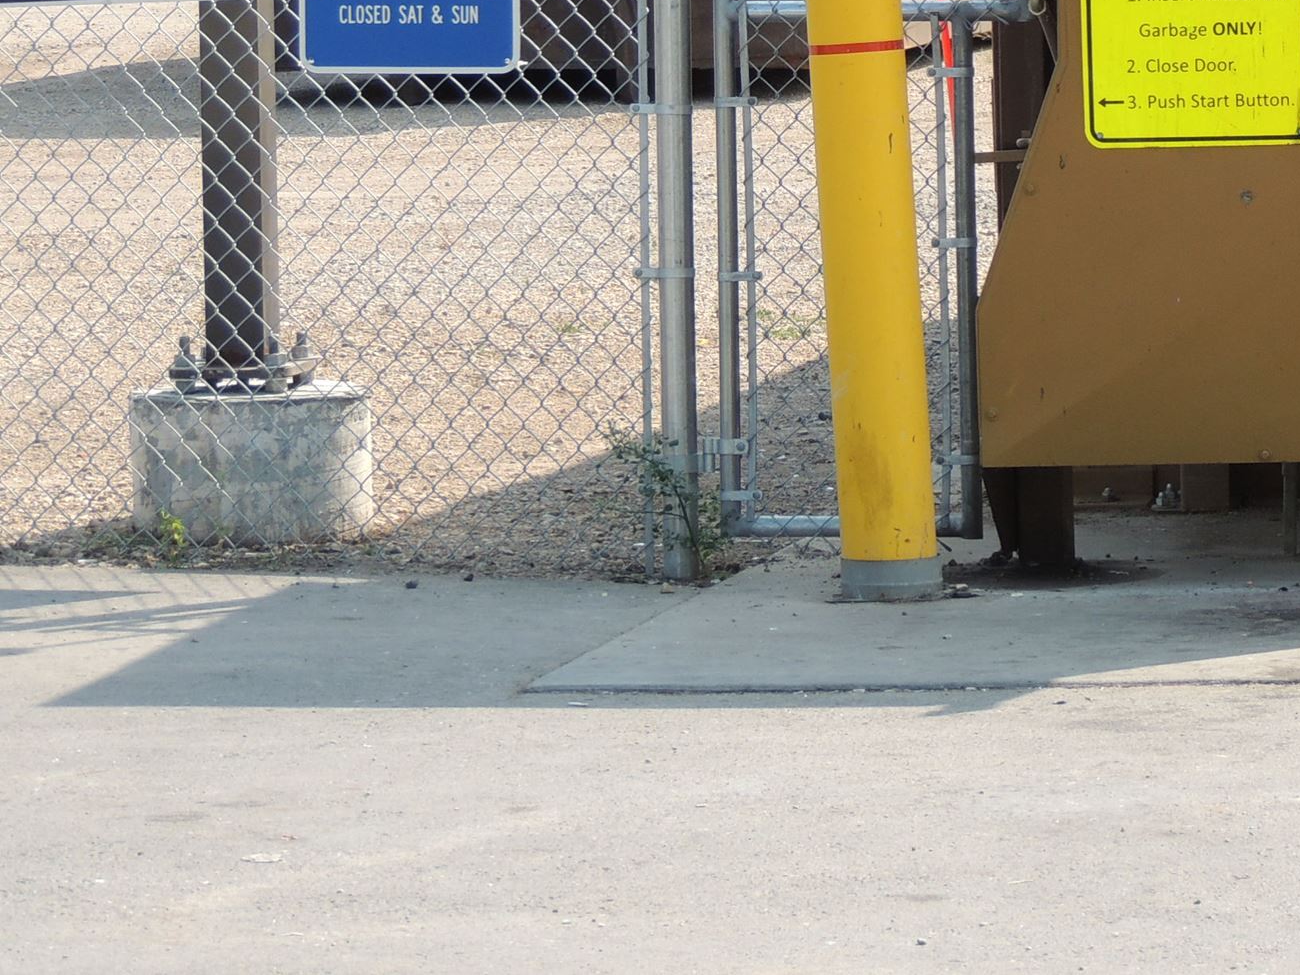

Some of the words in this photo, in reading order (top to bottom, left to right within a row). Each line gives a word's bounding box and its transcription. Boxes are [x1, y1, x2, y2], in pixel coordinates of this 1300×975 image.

[339, 5, 391, 25] CLOSED
[398, 5, 424, 25] SAT
[431, 5, 443, 25] &
[451, 5, 479, 25] SUN
[1139, 23, 1207, 39] Garbage
[1212, 21, 1262, 36] ONLY!
[1127, 59, 1141, 73] 2.
[1145, 59, 1189, 73] Close
[1194, 59, 1237, 73] Door.
[1127, 95, 1141, 109] 3.
[1147, 95, 1186, 109] Push
[1191, 94, 1229, 109] Start
[1235, 92, 1295, 107] Button.
